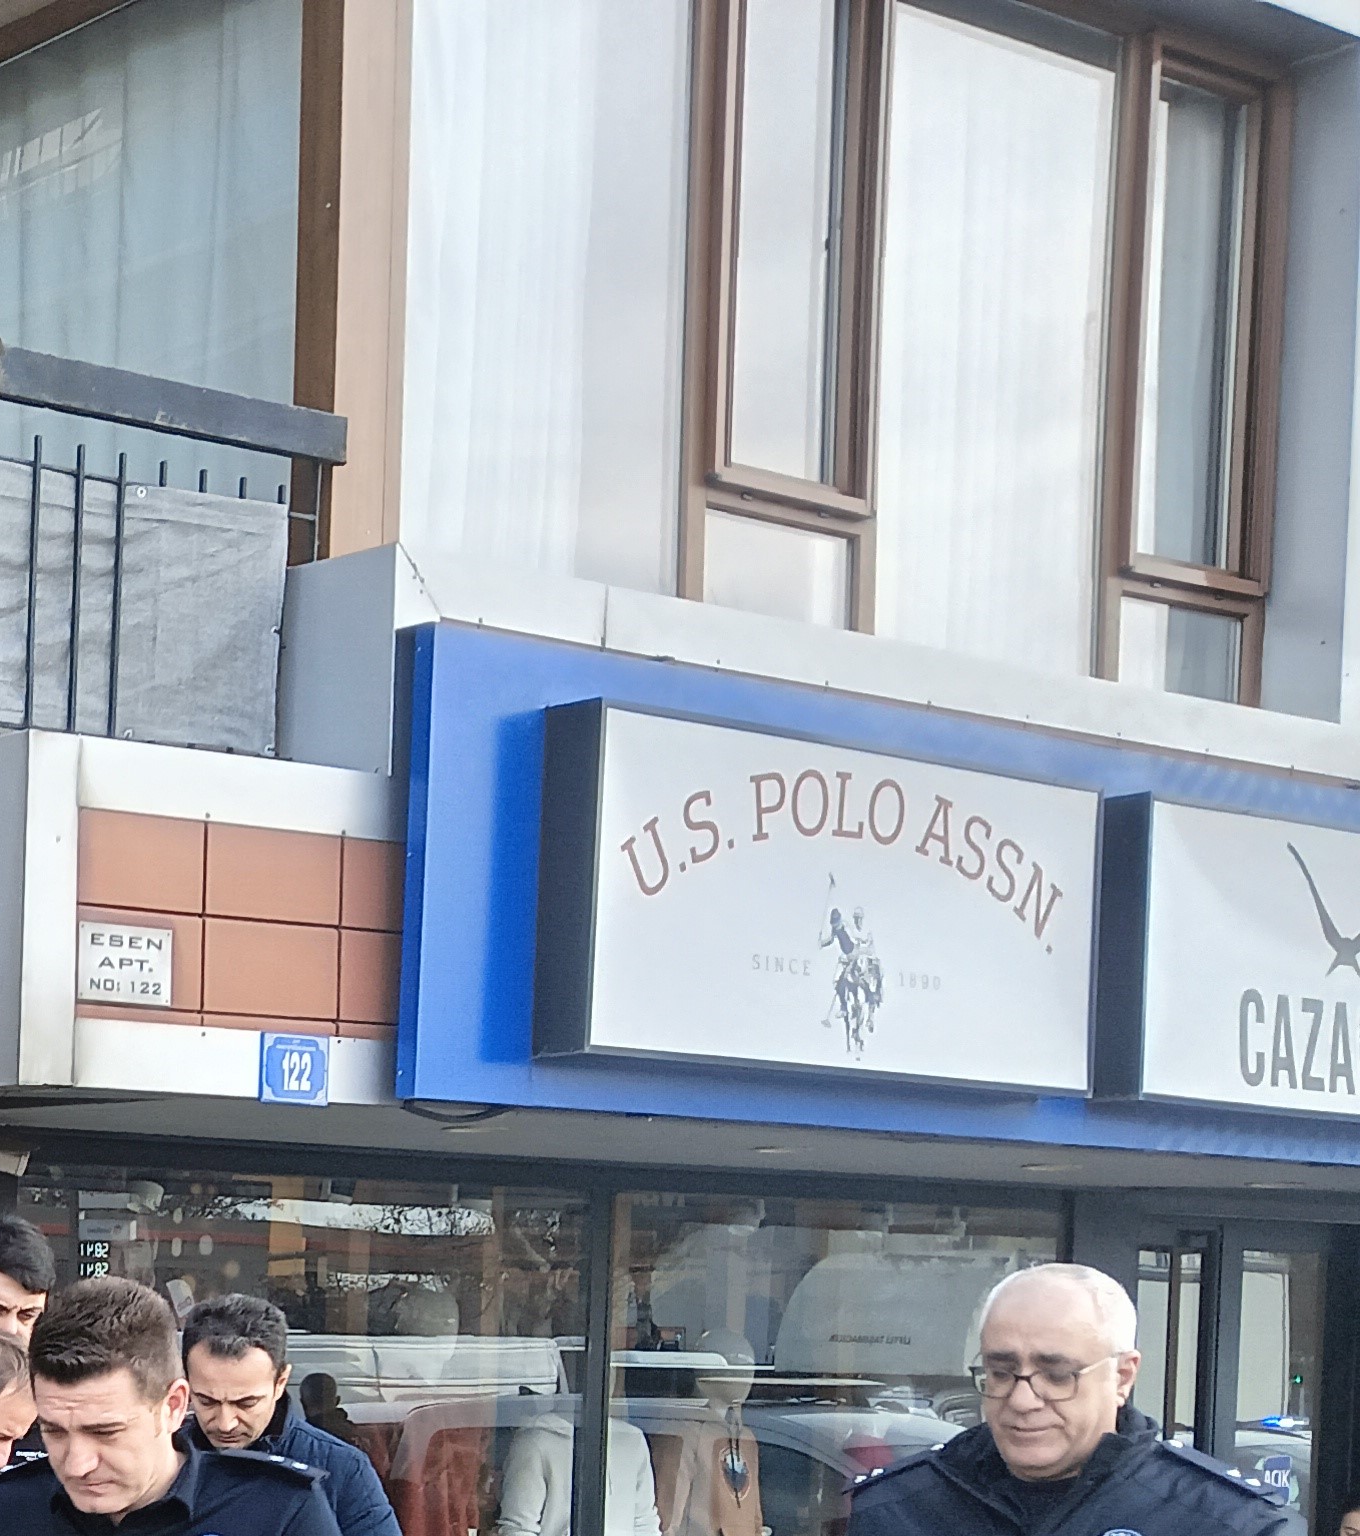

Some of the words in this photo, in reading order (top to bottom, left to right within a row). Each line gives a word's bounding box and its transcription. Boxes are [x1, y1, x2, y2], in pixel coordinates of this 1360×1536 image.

[621, 790, 735, 896] U.S.
[749, 769, 905, 845] POLO
[915, 794, 1063, 955] ASSN.
[90, 933, 163, 951] ESEN
[98, 956, 154, 973] APT.
[752, 954, 812, 977] SINCE
[898, 971, 942, 991] 1890
[89, 977, 121, 993] NO:
[130, 981, 162, 996] 122
[1239, 988, 1360, 1095] CAZA
[282, 1050, 312, 1091] 122
